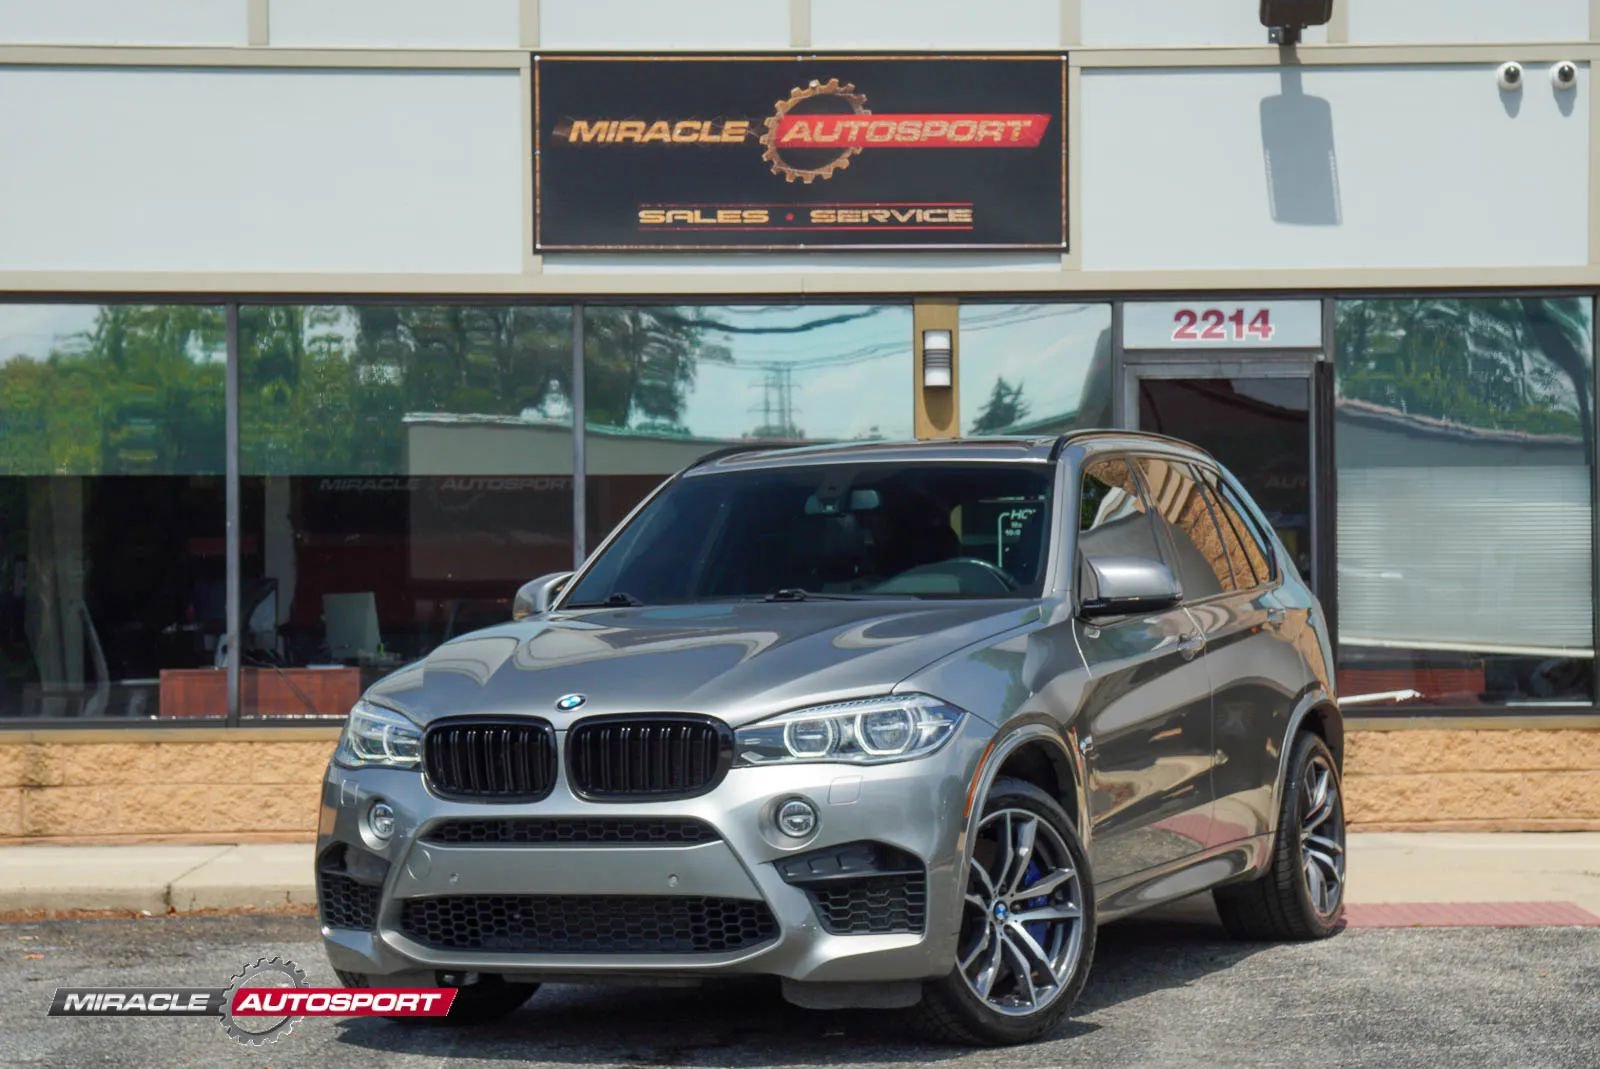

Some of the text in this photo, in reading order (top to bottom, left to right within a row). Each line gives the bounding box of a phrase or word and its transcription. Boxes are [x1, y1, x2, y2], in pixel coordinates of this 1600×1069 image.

[569, 119, 1032, 143] MIRACLE AUTOSPORT
[638, 208, 973, 223] SALES SERVICE
[1173, 308, 1273, 340] 2214
[320, 478, 421, 491] MIRACLE
